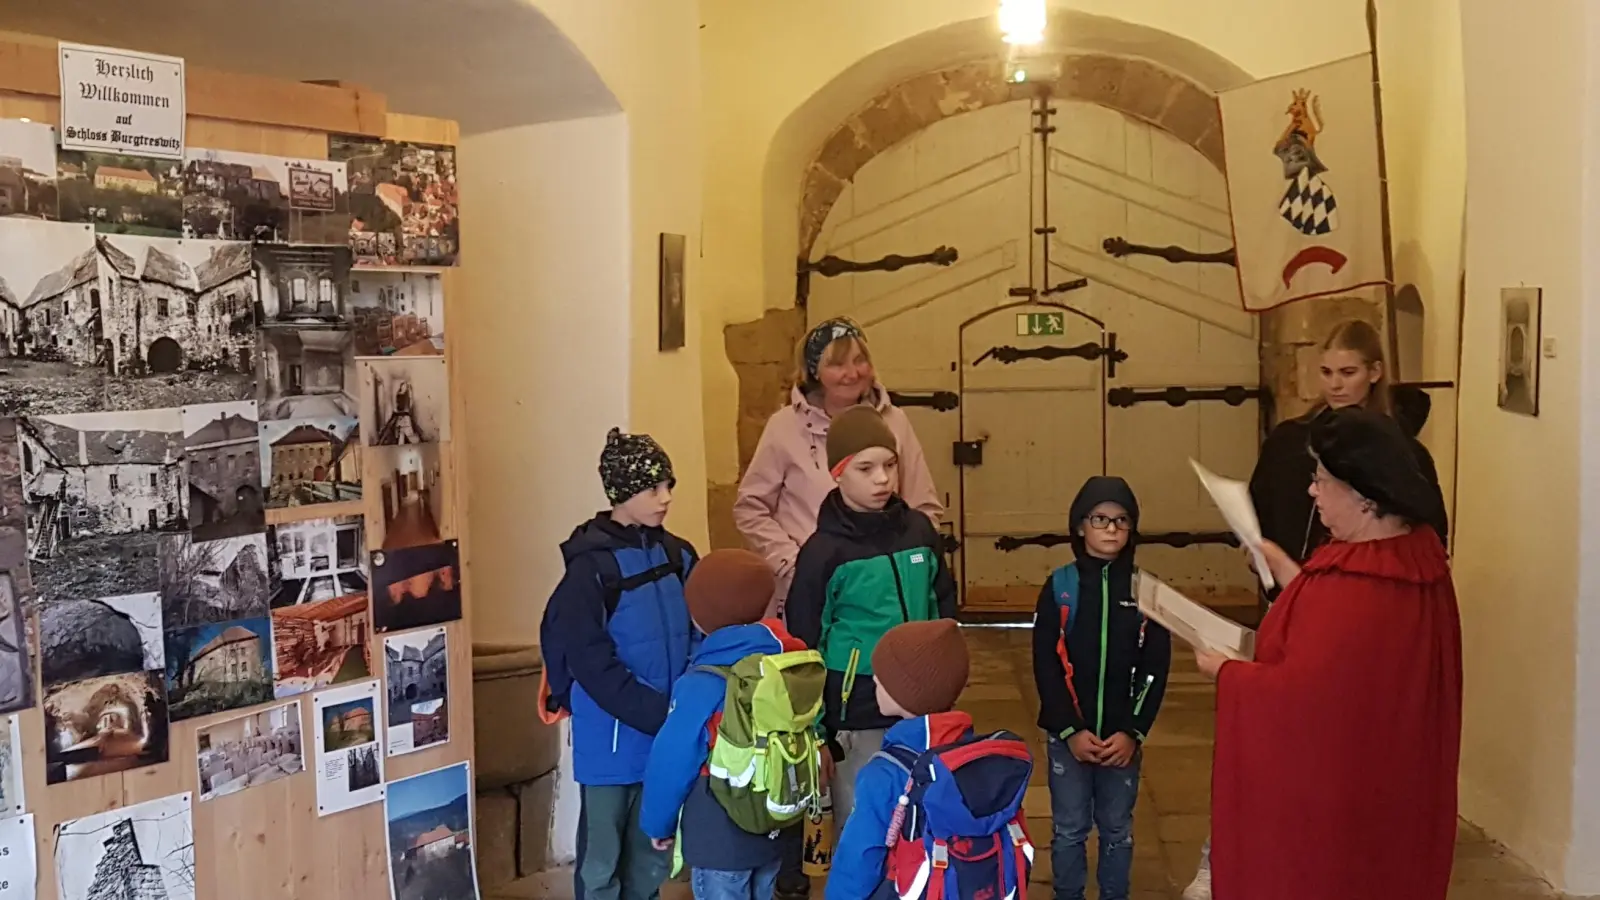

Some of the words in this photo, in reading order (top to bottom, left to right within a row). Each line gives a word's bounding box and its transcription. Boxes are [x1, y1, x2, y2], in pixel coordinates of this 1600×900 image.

[95, 58, 154, 83] Herzlich
[79, 82, 170, 108] Willkommen
[115, 114, 133, 126] auf
[66, 126, 107, 141] Schloss
[110, 130, 180, 150] Burgtreswitz
